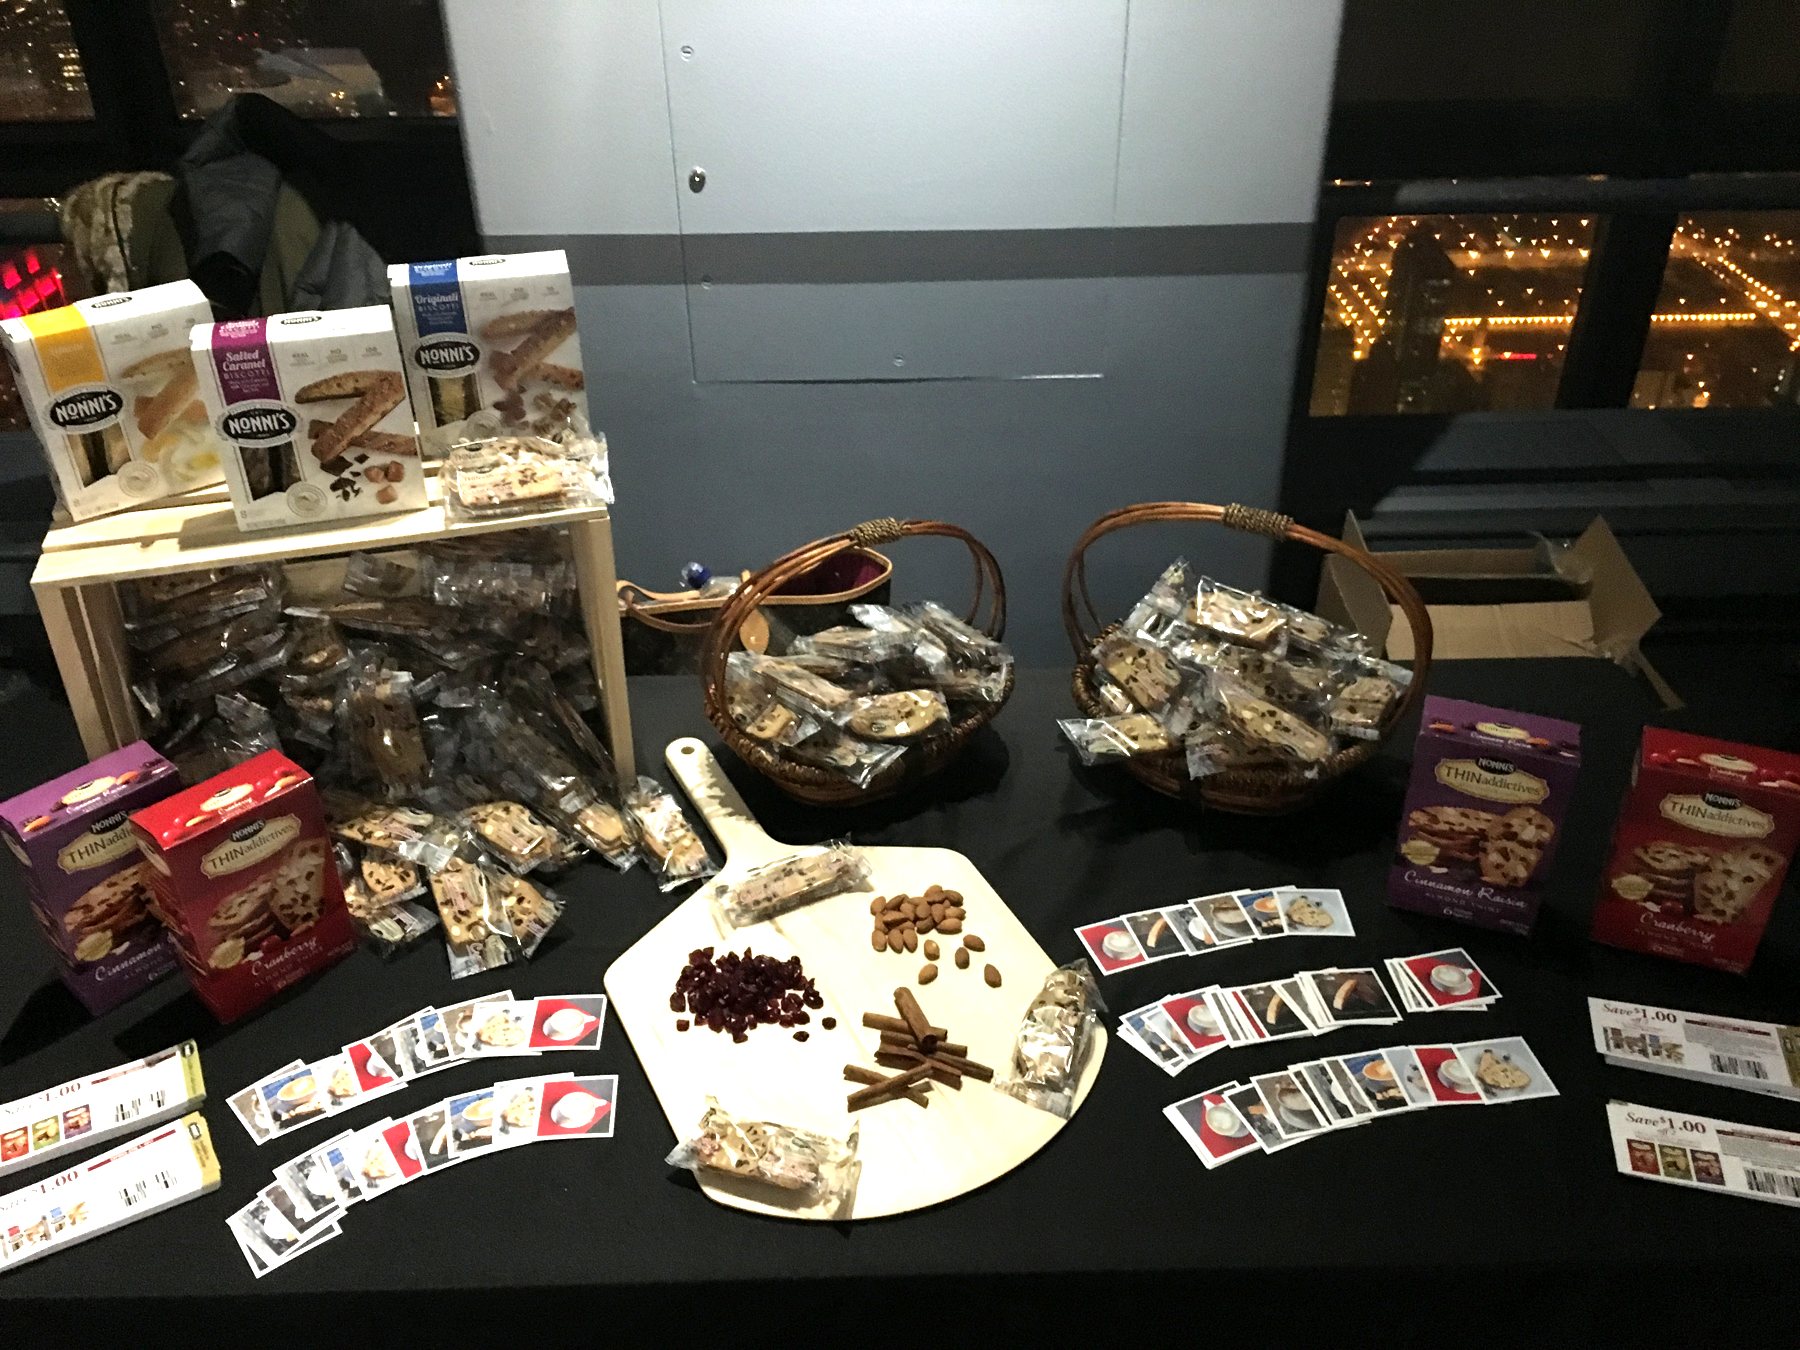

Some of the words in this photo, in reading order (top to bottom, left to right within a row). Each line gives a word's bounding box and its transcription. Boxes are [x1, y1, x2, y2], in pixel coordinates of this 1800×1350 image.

[222, 358, 266, 372] Caramel
[226, 350, 259, 362] Salted
[420, 345, 475, 365] NONNI'S
[55, 394, 118, 422] NONNI'S
[228, 413, 291, 435] NONNI'S
[1478, 757, 1515, 773] NONNI'S
[1445, 765, 1540, 796] THINaddictives
[1705, 792, 1741, 807] NONNI'S
[91, 810, 128, 833] NONNI'S
[232, 820, 265, 841] NONNI'S
[208, 824, 295, 870] THINaddictives
[1404, 870, 1474, 896] Cinnamon
[1478, 887, 1527, 909] Raisin
[1640, 911, 1716, 944] Cranberry
[252, 936, 318, 976] Cranberry
[1603, 1003, 1633, 1016] Save
[1625, 1111, 1659, 1127] Save
[1660, 1116, 1707, 1135] $1.00
